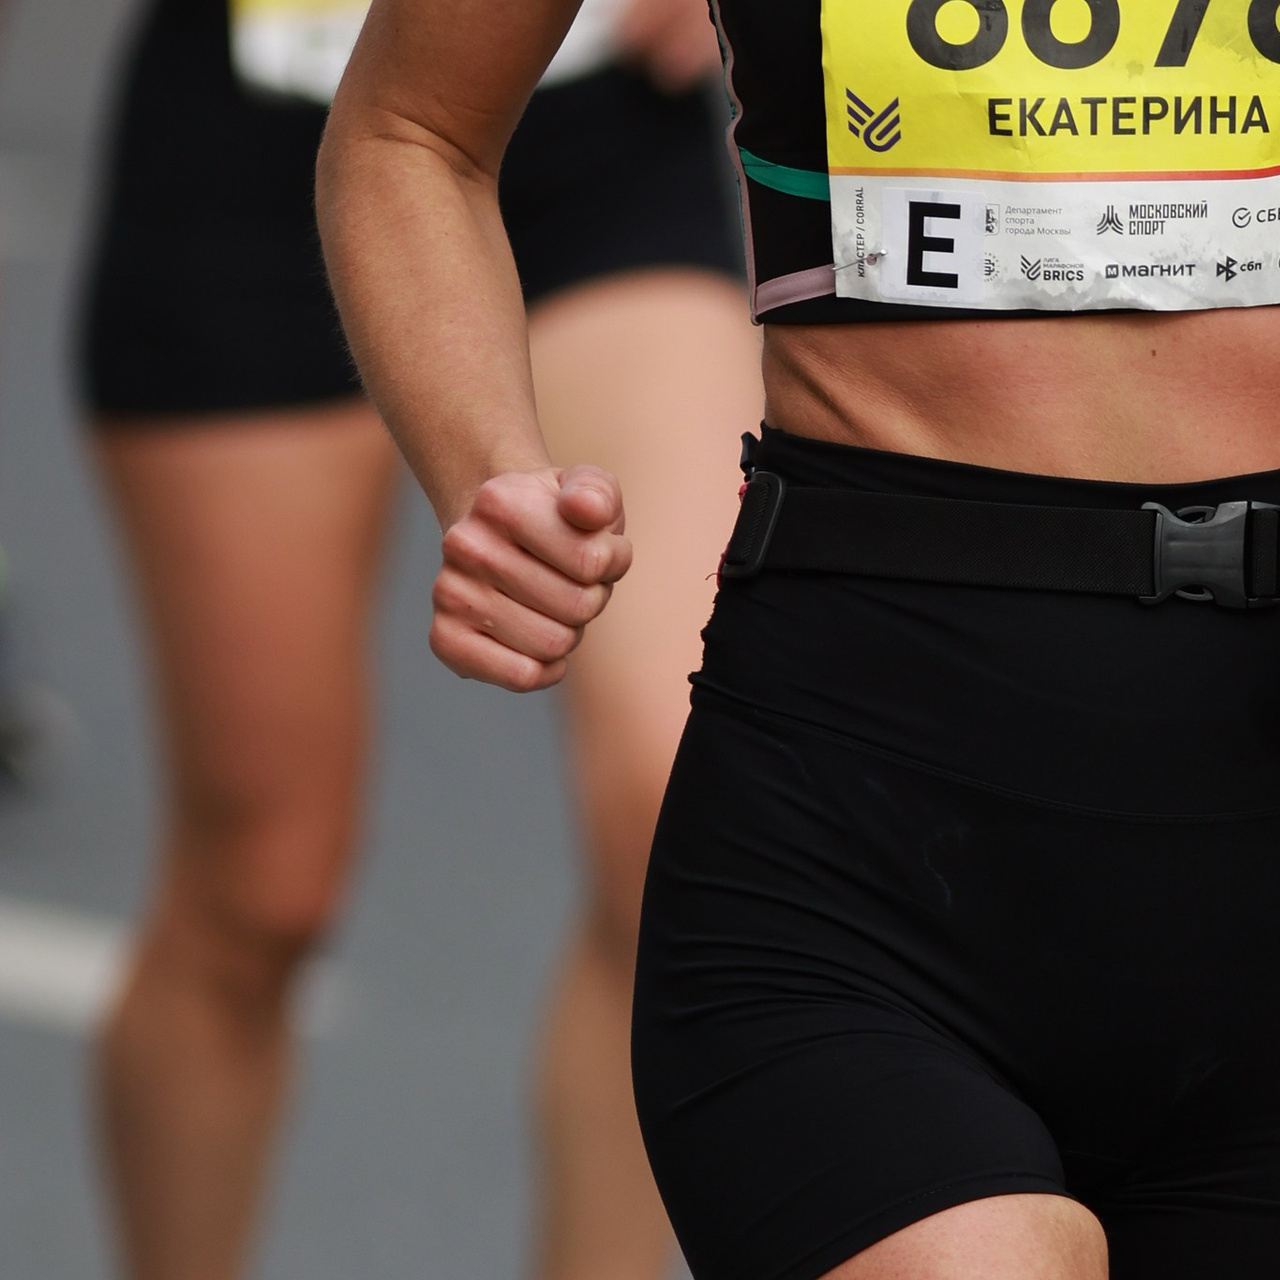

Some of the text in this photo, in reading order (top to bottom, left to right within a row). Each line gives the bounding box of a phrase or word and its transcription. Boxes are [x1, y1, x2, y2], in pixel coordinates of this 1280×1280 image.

[988, 94, 1271, 137] ЕКАТЕРИНА
[855, 187, 865, 225] CORRAL
[1005, 206, 1063, 215] Департамент
[1129, 200, 1208, 219] МОСКОВСКИЙ
[1005, 217, 1035, 225] спорта
[1129, 220, 1166, 235] СПОРТ
[1005, 228, 1071, 236] города Москвы
[906, 201, 961, 289] E
[1240, 261, 1262, 272] сбп
[1043, 270, 1084, 281] BRICS
